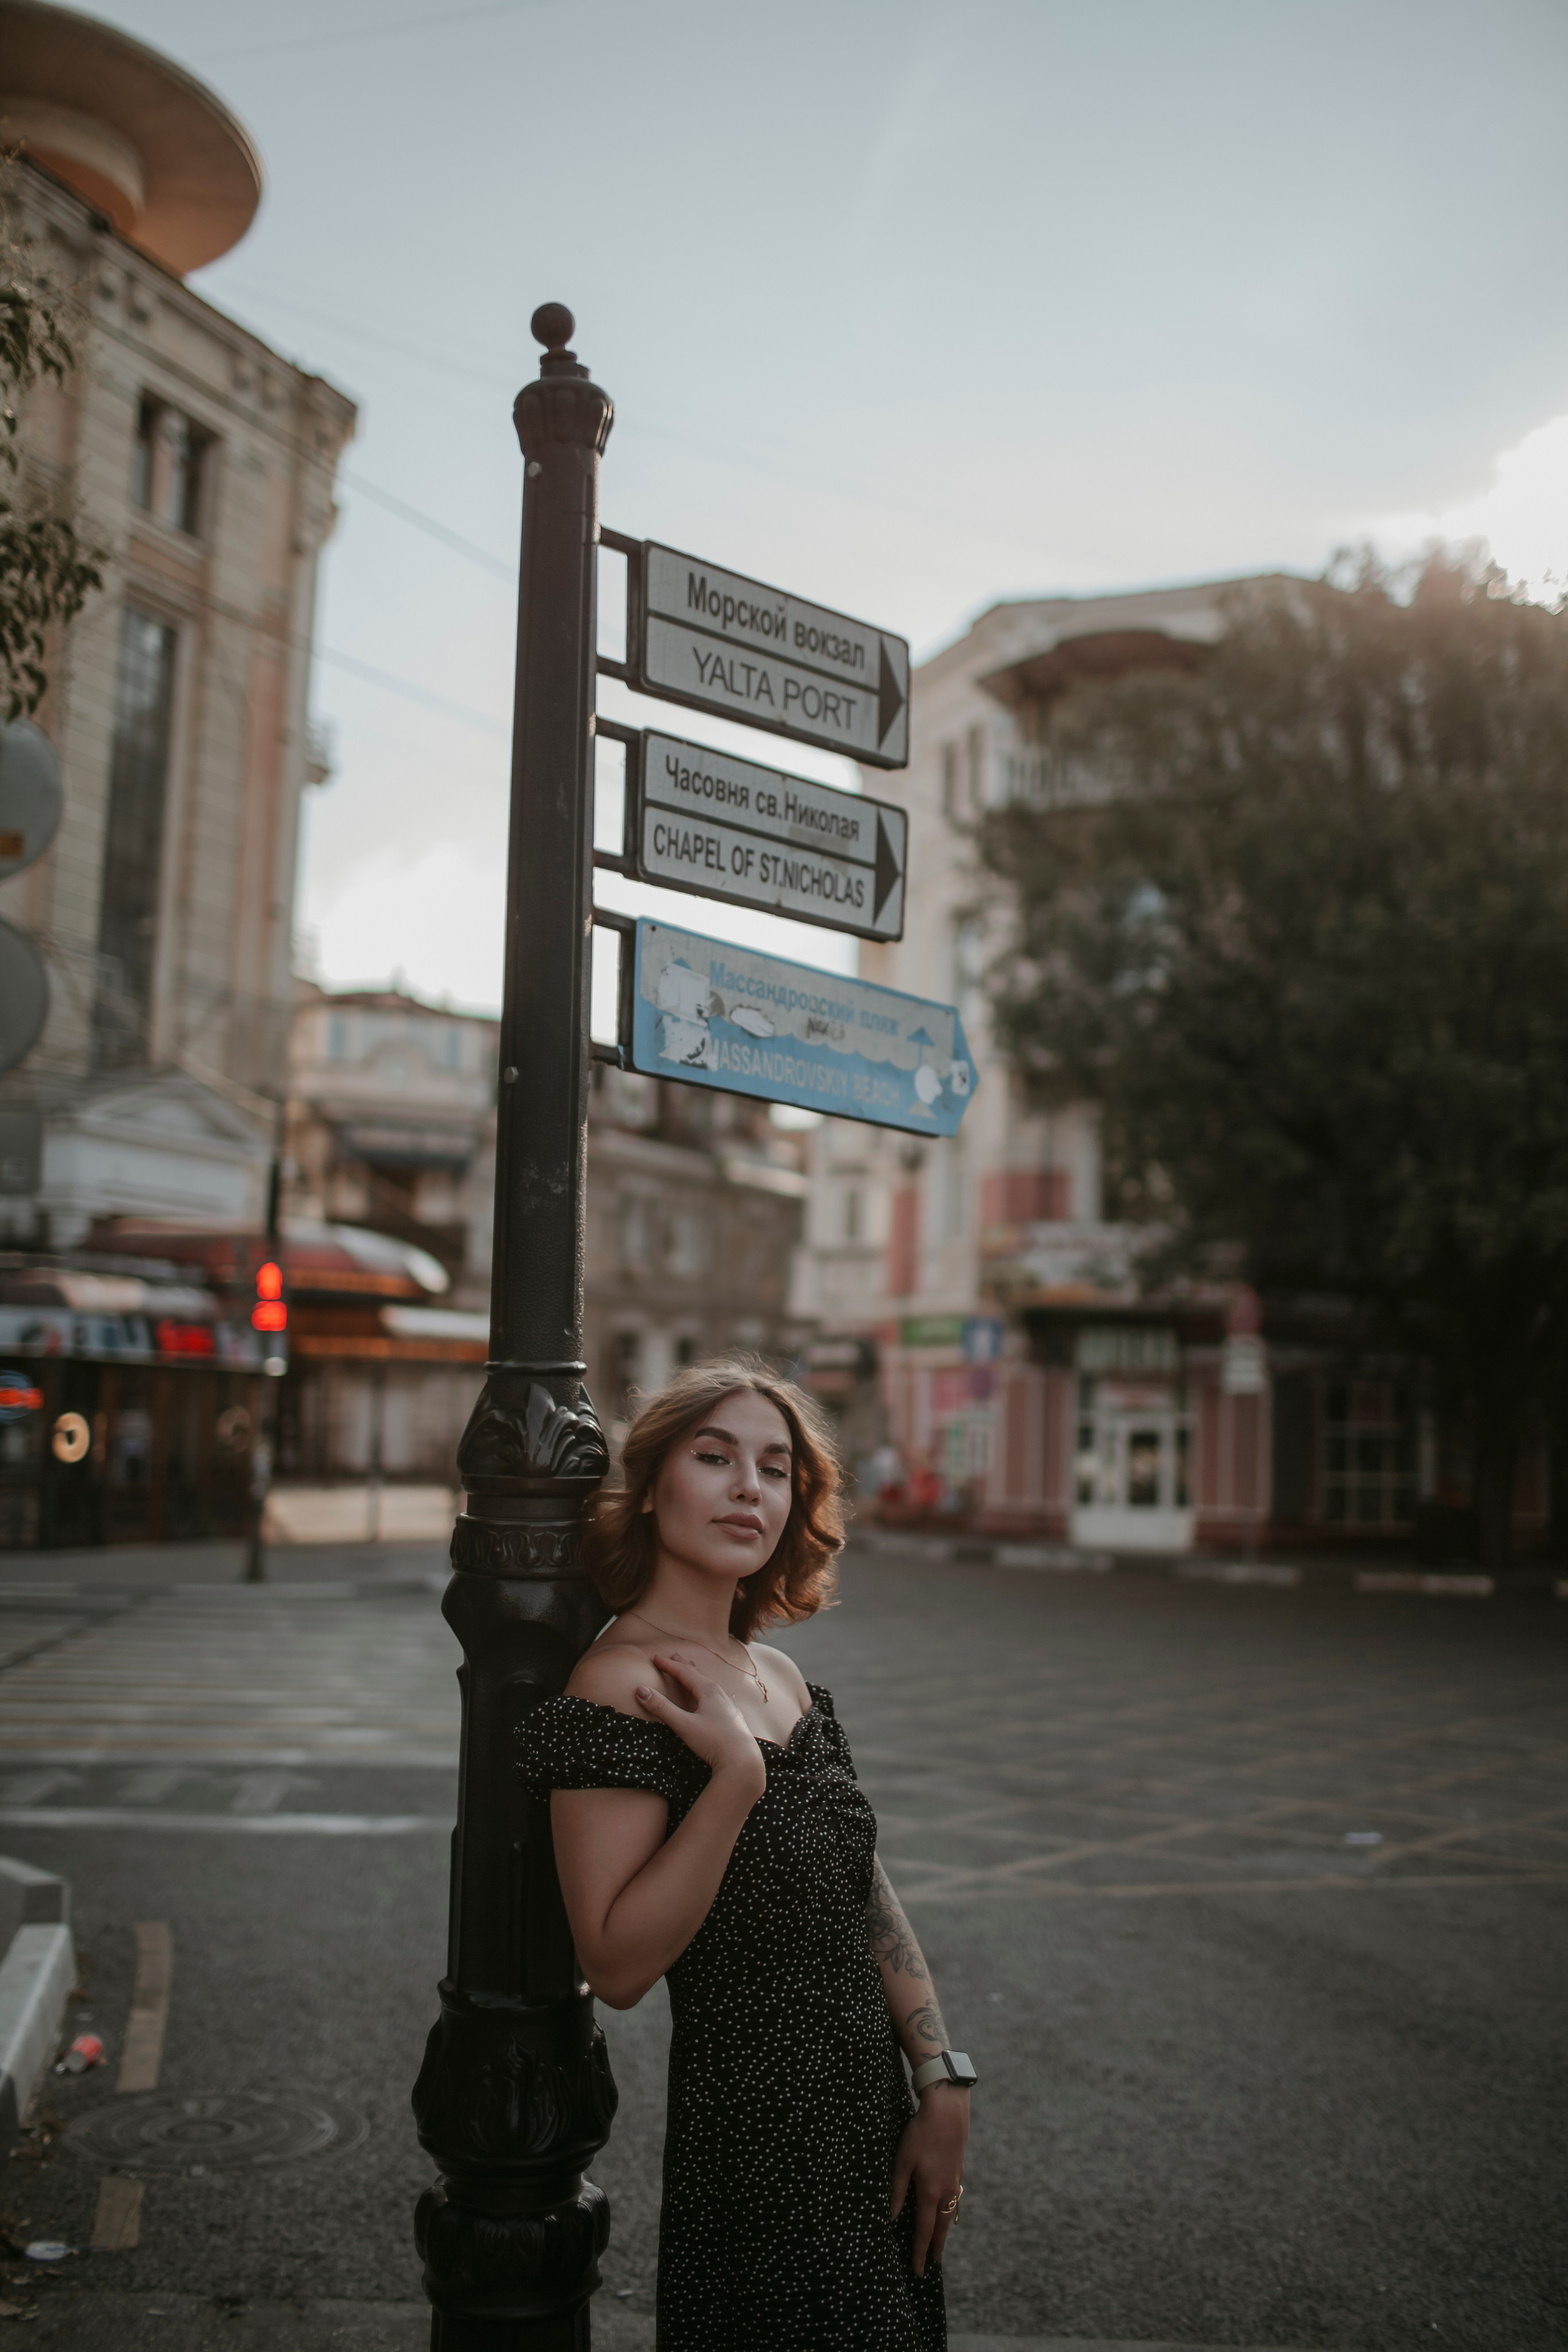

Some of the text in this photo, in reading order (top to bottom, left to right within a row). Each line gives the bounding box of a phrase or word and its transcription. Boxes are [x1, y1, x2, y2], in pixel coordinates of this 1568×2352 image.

[688, 571, 865, 670] Морской вокзал
[693, 646, 858, 730] YALTA PORT
[665, 754, 750, 810] Часовня
[653, 823, 726, 872] CHAPEL
[731, 845, 756, 877] OF
[853, 1072, 901, 1109] BEACH
